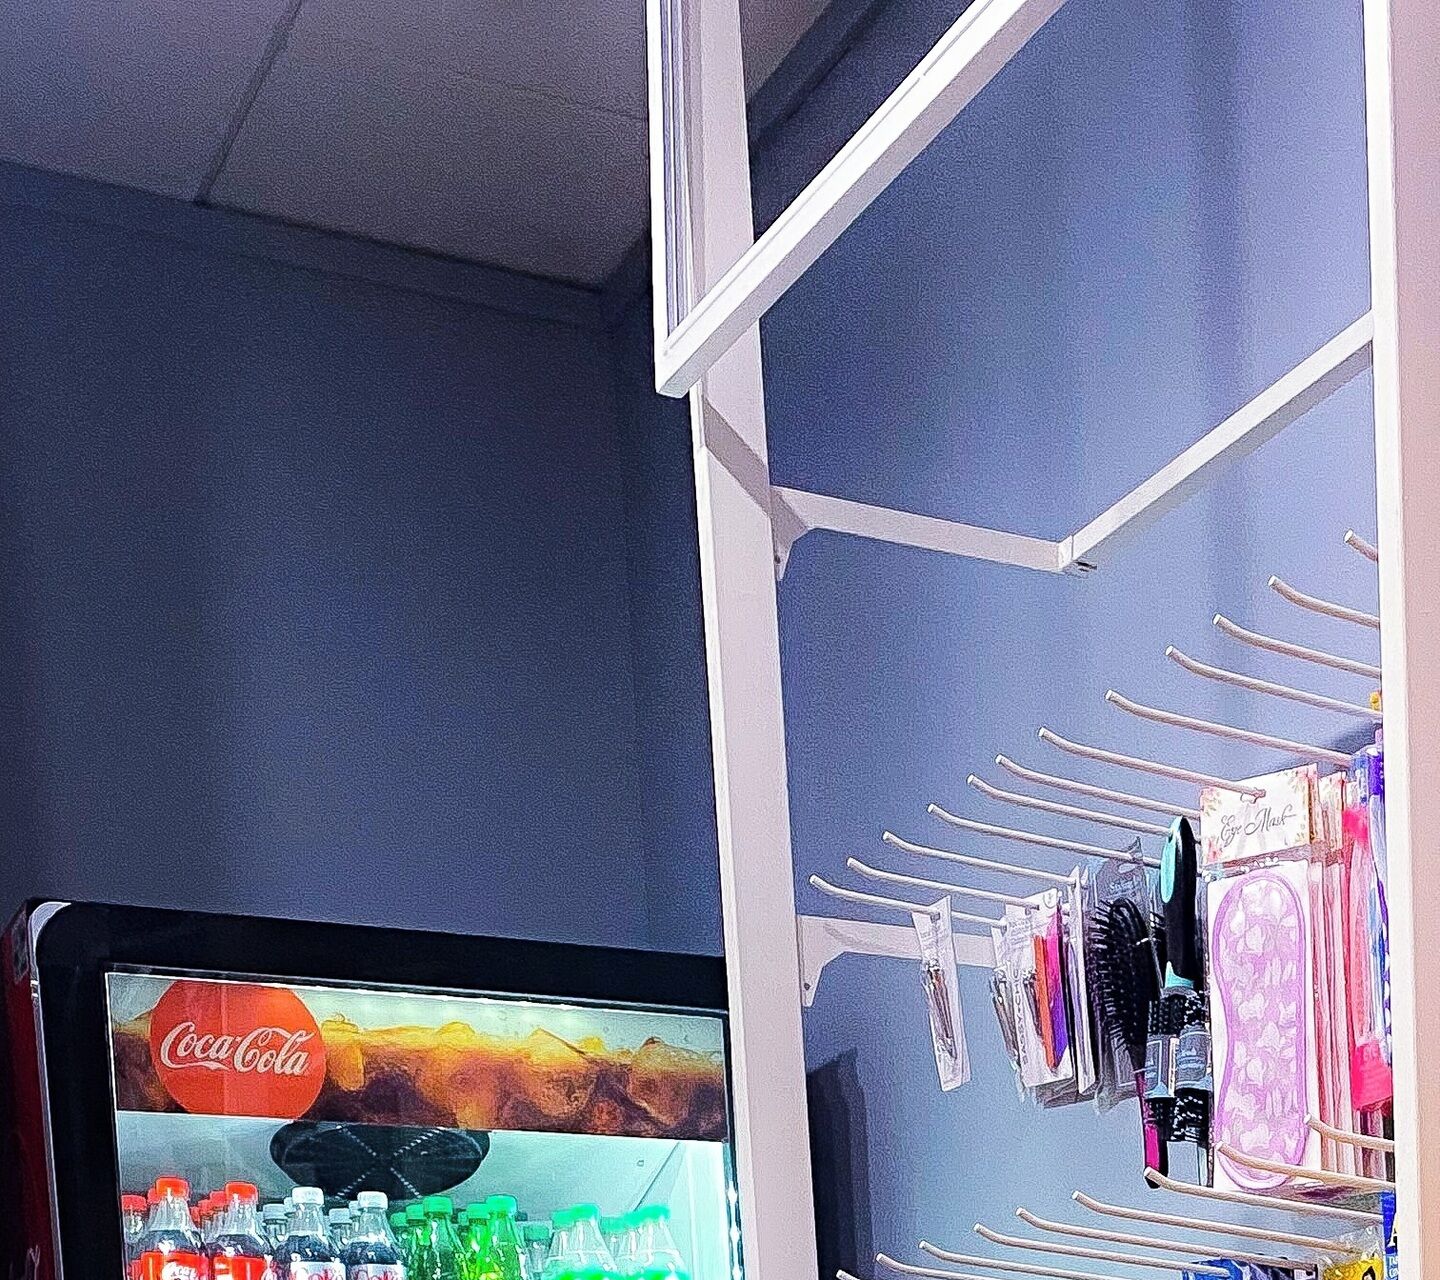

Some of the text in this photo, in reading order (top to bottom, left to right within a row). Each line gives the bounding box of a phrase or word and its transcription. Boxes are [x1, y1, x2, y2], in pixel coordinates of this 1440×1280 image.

[1220, 806, 1299, 843] Eye Mask
[159, 1020, 315, 1078] Coca-Cola
